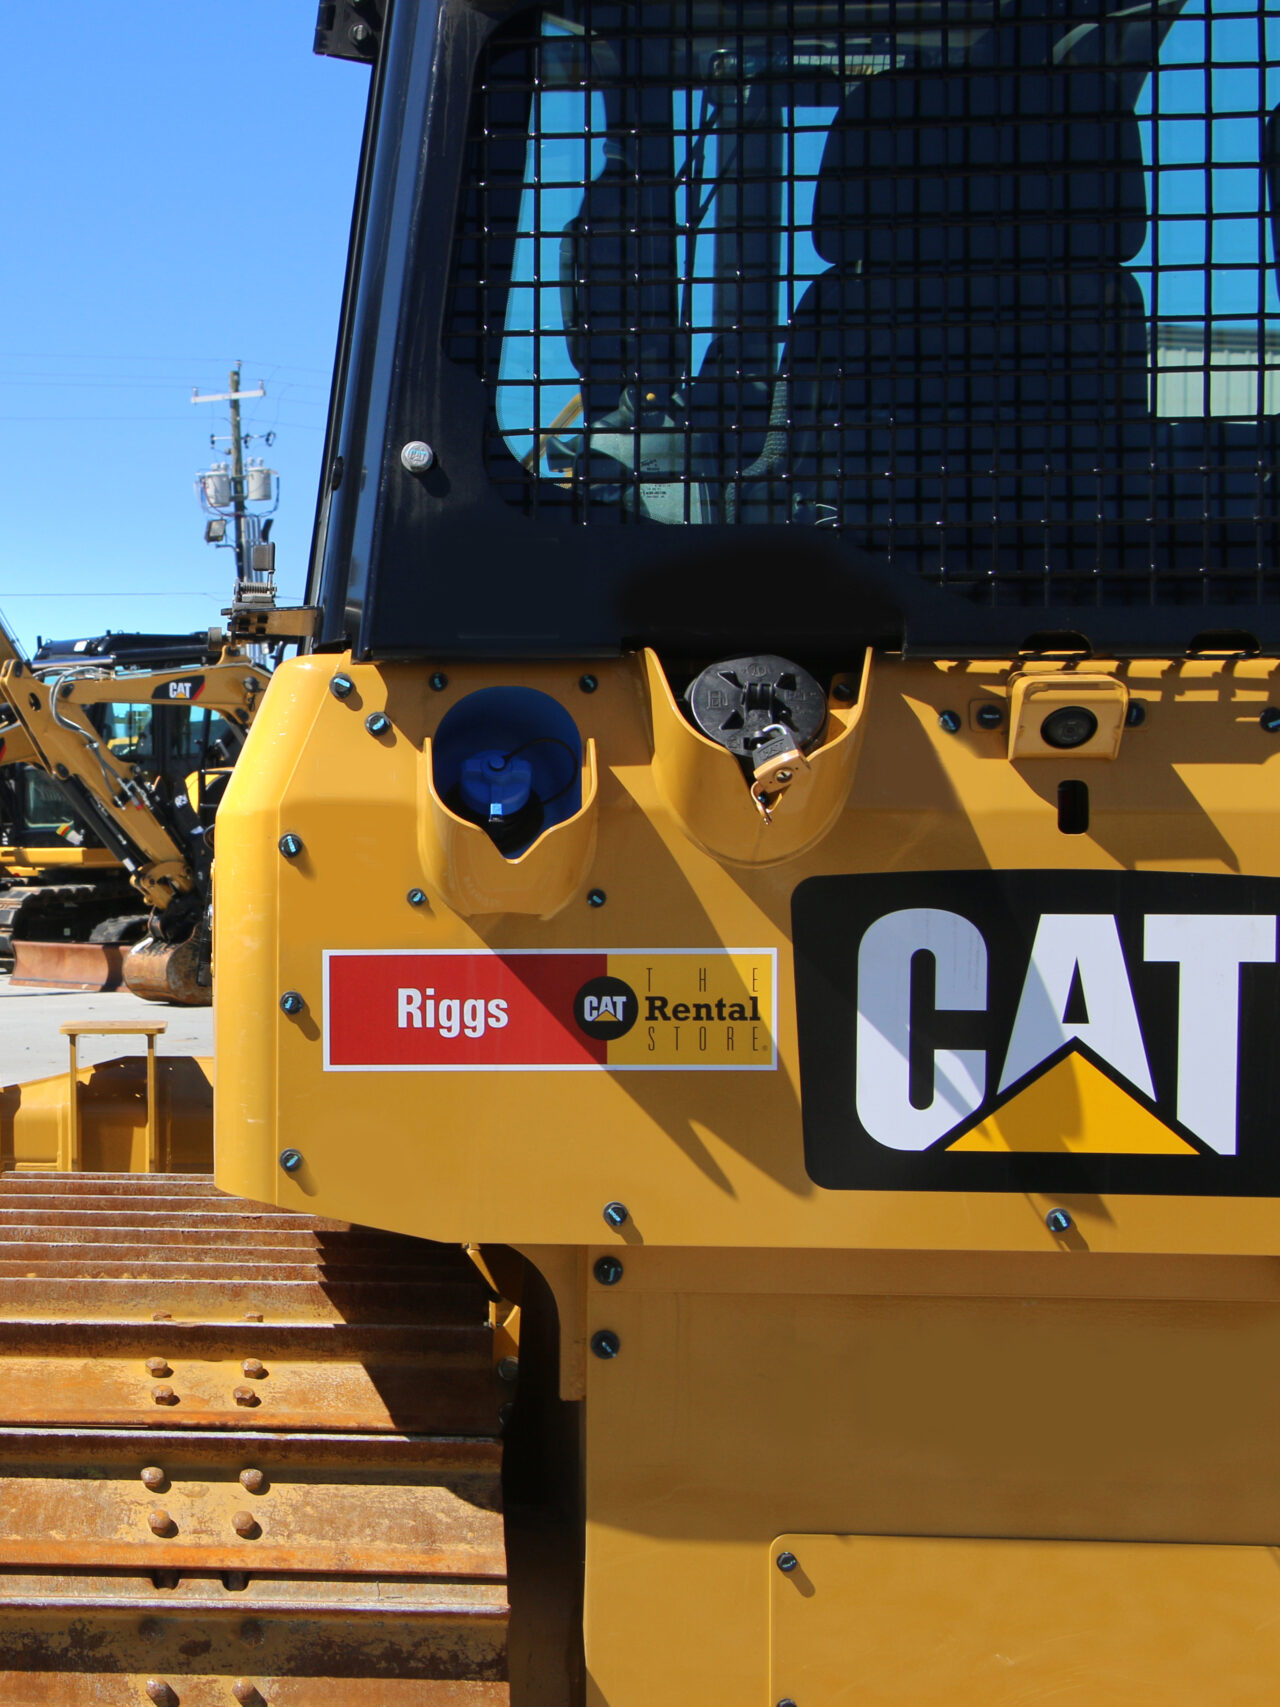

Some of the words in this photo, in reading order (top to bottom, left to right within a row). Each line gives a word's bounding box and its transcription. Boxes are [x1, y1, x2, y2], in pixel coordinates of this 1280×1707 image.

[169, 682, 192, 699] CAT
[646, 967, 758, 992] THE
[397, 988, 509, 1038] Riggs
[583, 996, 627, 1022] CAT
[645, 996, 761, 1021] Rental
[648, 1026, 759, 1051] STORE
[856, 908, 1277, 1155] CAT
